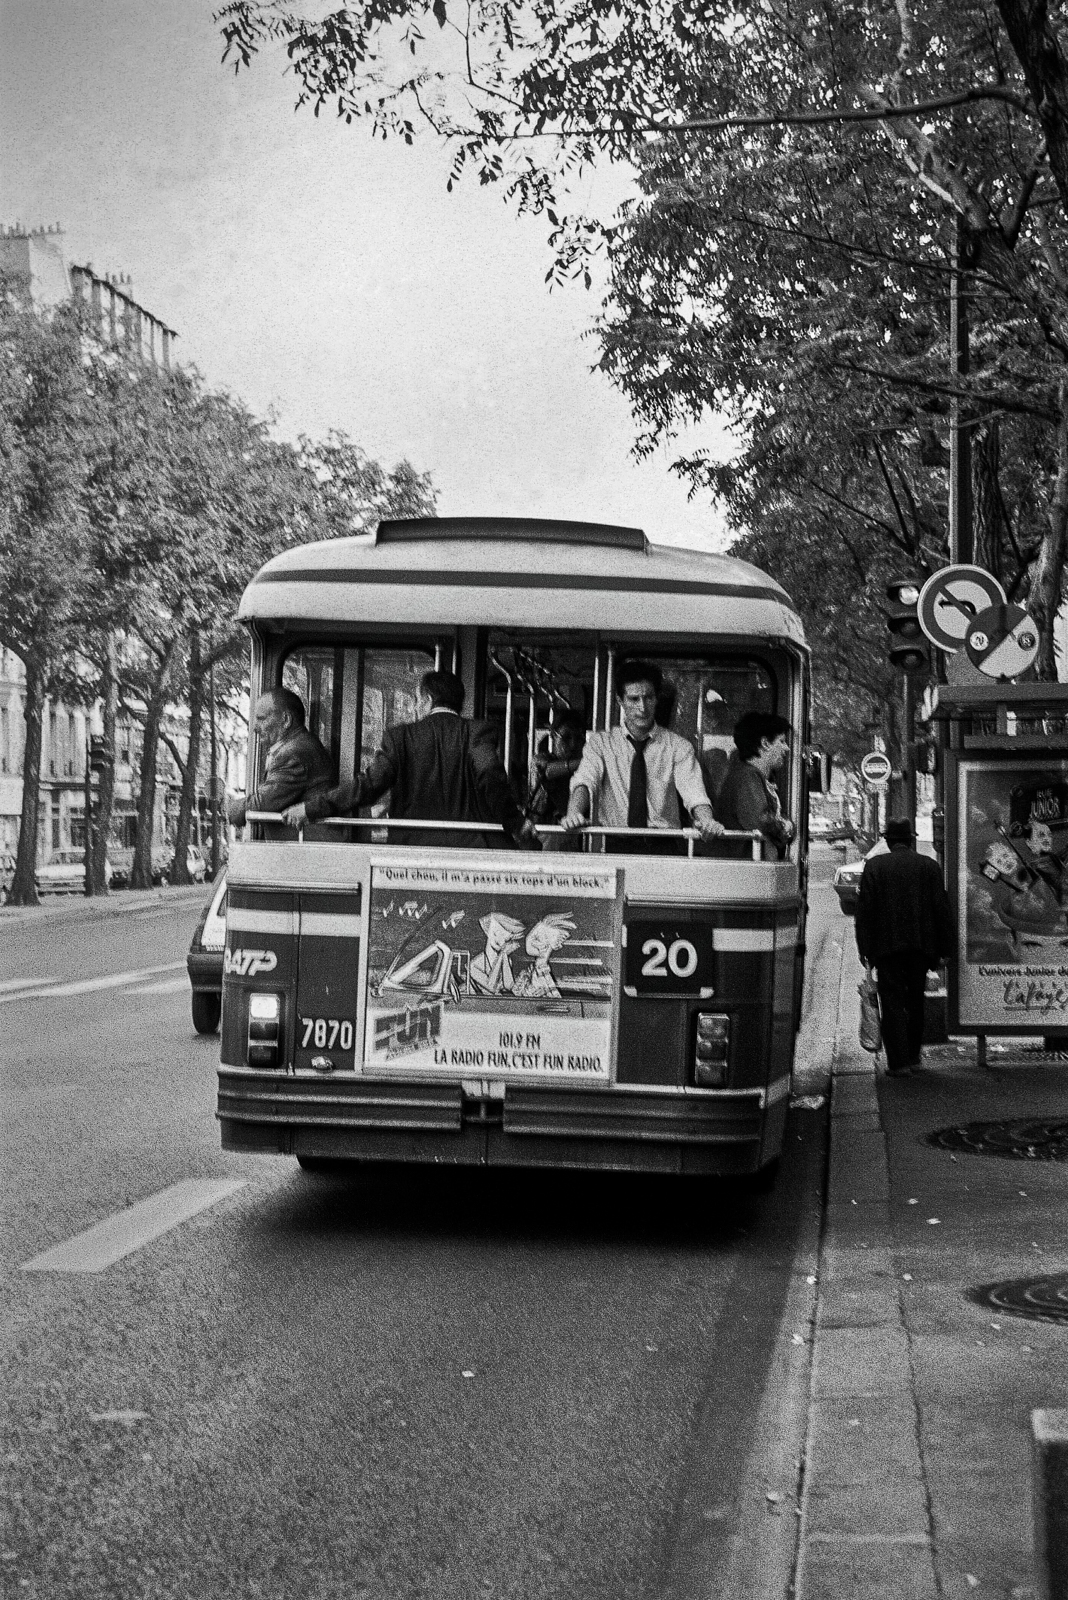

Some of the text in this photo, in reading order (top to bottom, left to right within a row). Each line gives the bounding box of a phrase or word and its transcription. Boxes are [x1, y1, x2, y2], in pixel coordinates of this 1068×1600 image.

[1029, 797, 1061, 818] JUNIOR
[442, 869, 448, 881] il
[451, 870, 470, 882] m'a
[547, 874, 569, 887] d'un
[641, 938, 698, 978] 20
[301, 1017, 354, 1051] 7870
[499, 1031, 541, 1050] 101.9 FM
[434, 1047, 448, 1065] LA
[450, 1047, 485, 1067] RADIO
[543, 1052, 564, 1072] FUN
